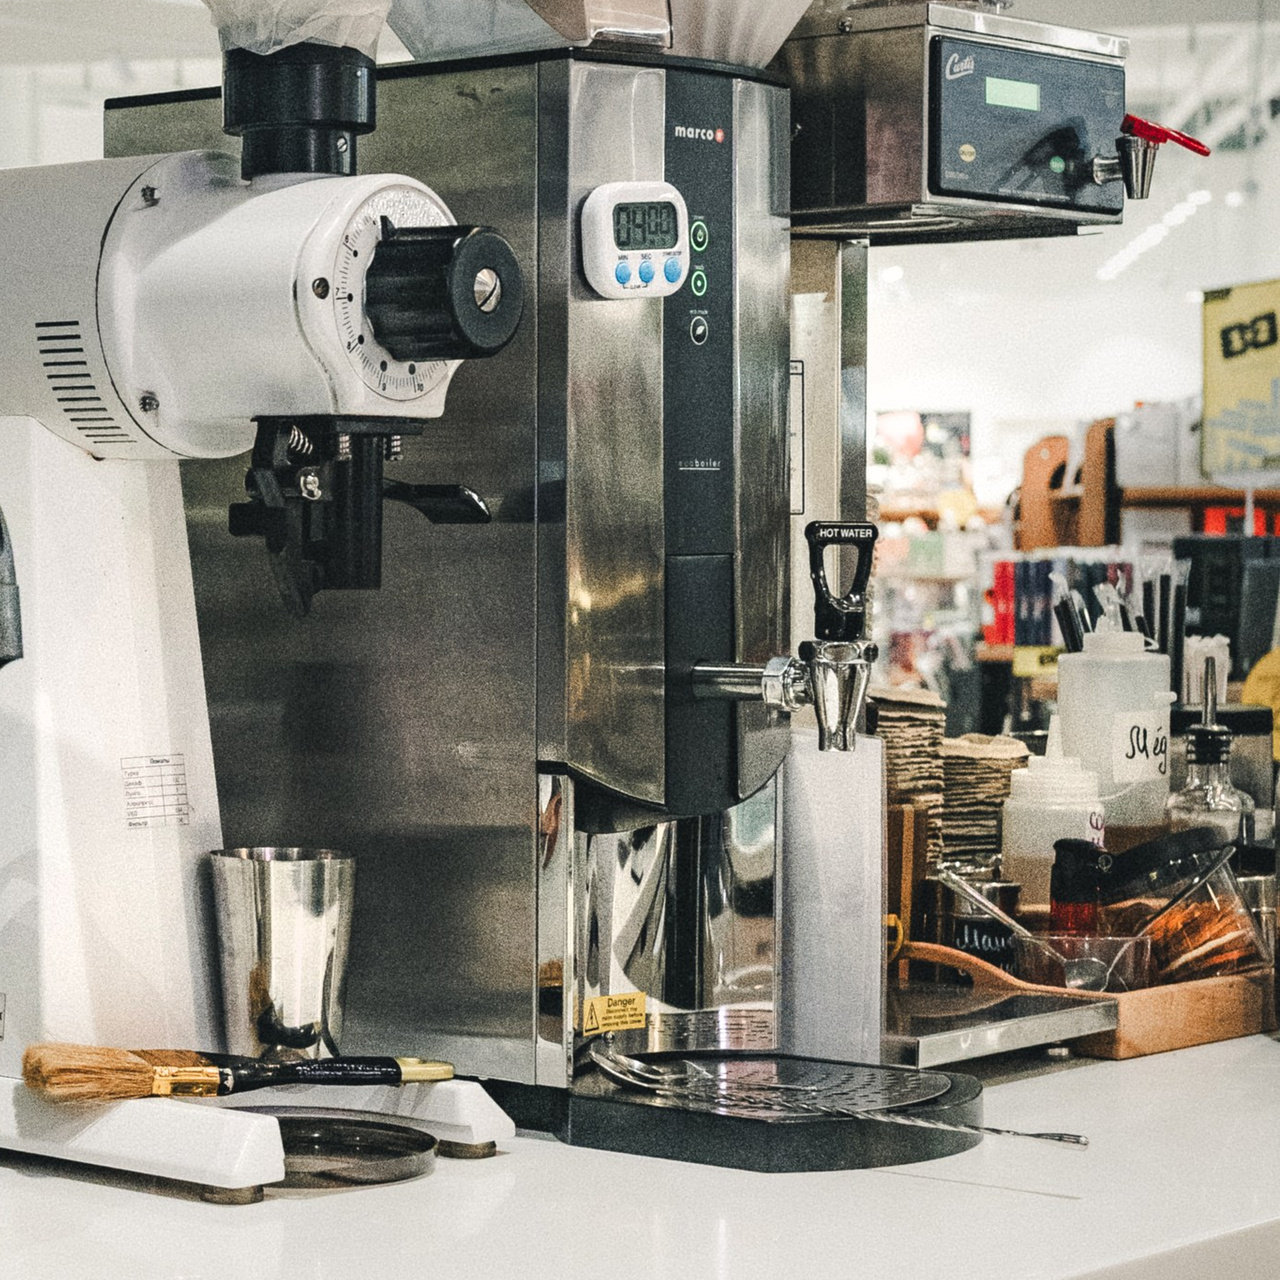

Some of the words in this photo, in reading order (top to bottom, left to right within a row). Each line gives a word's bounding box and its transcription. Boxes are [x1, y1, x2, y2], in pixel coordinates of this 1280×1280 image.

[945, 53, 975, 80] Curtis
[675, 126, 714, 140] marco
[335, 287, 340, 296] 7
[381, 382, 387, 392] 9
[417, 383, 424, 392] 10
[820, 528, 839, 538] HOT
[840, 528, 873, 538] WATER
[607, 997, 636, 1008] Danger
